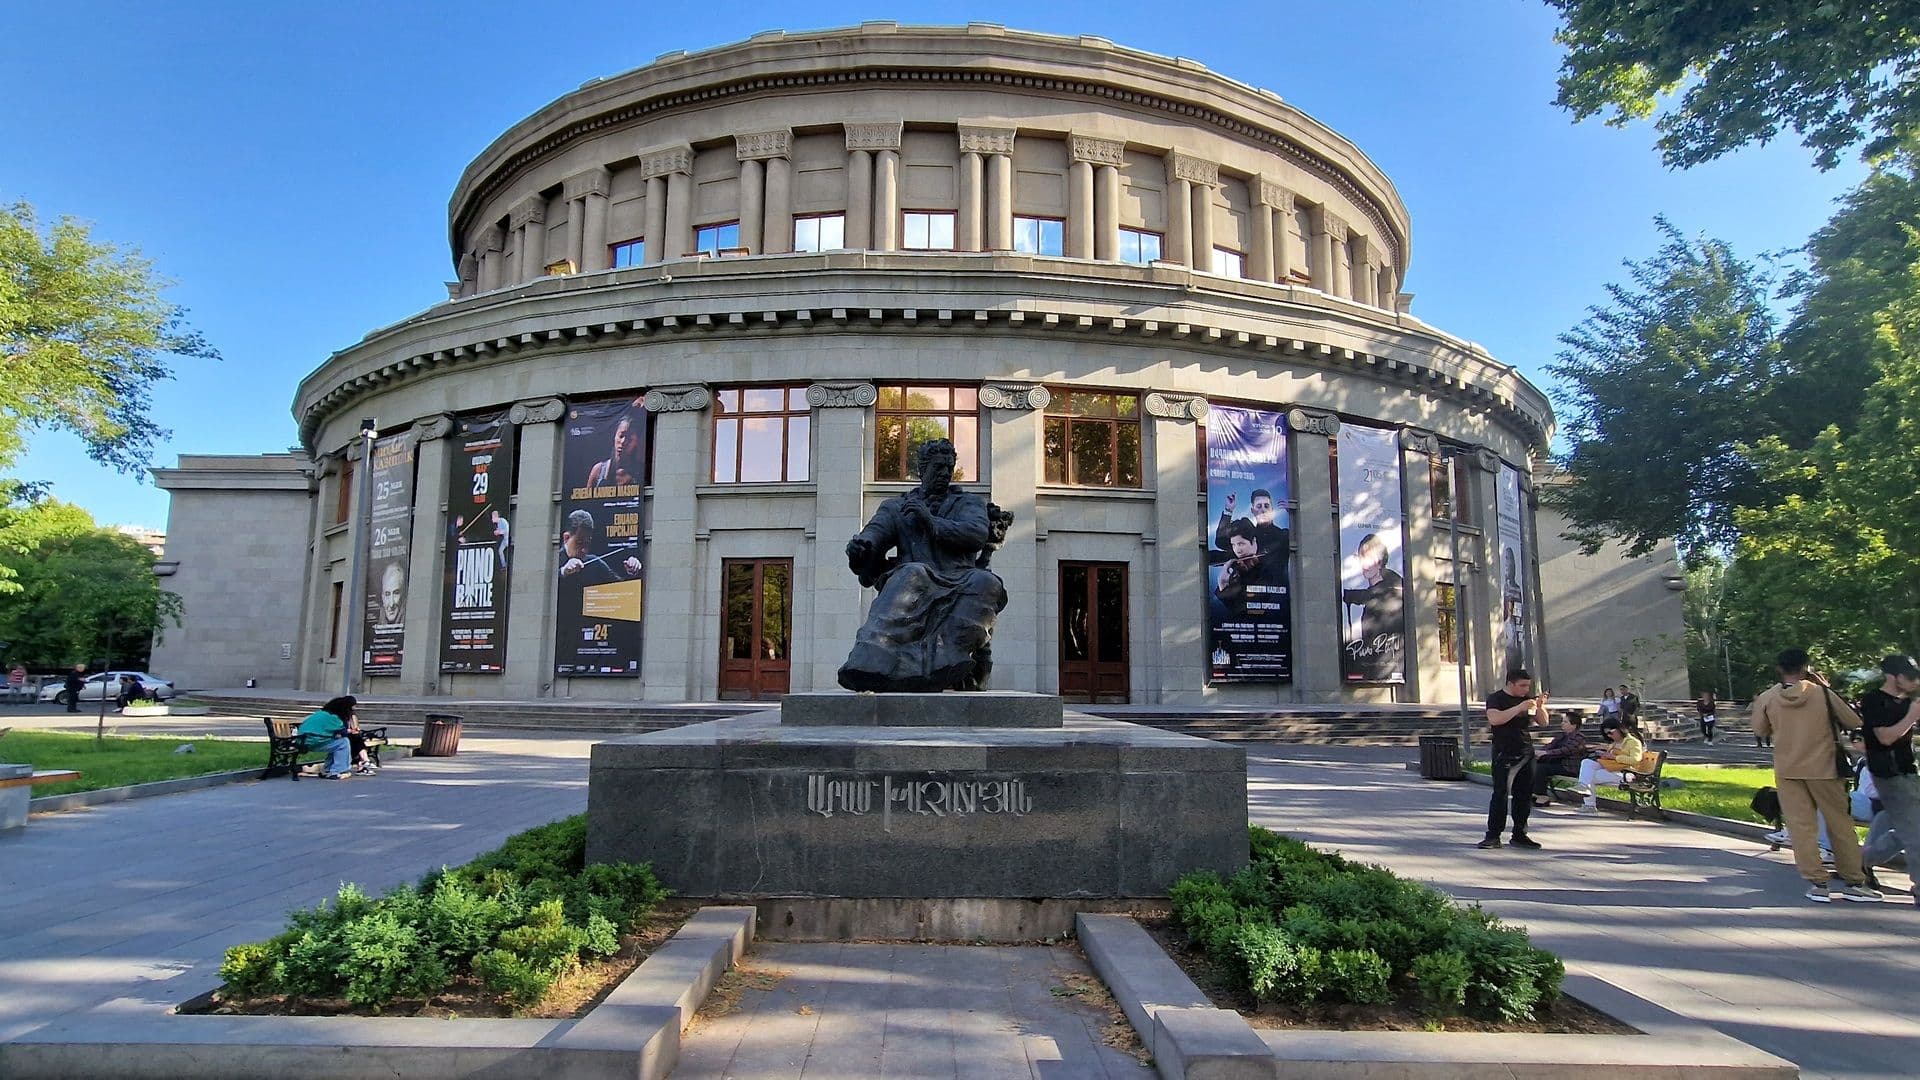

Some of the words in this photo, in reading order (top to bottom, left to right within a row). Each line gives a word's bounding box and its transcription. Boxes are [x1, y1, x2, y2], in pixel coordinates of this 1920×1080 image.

[377, 481, 389, 499] 25
[473, 472, 488, 495] 29
[374, 527, 387, 545] 26
[456, 548, 494, 585] PIANO
[455, 582, 493, 608] BATTLE
[594, 624, 608, 640] 24
